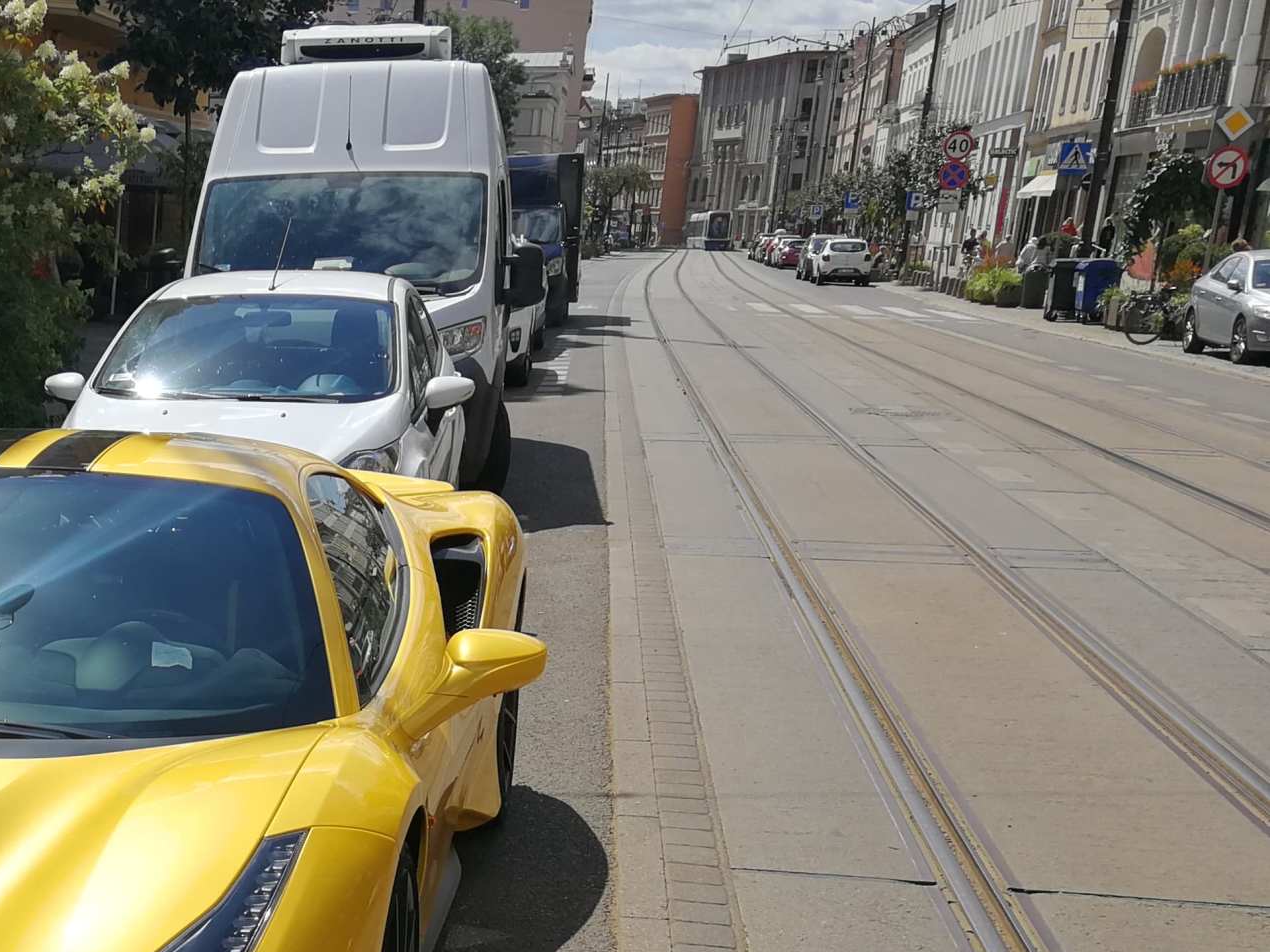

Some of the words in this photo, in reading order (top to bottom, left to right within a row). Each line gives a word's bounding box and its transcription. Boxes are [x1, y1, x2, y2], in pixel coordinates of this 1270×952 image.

[948, 138, 969, 153] 40
[910, 193, 923, 208] P
[813, 206, 820, 215] P
